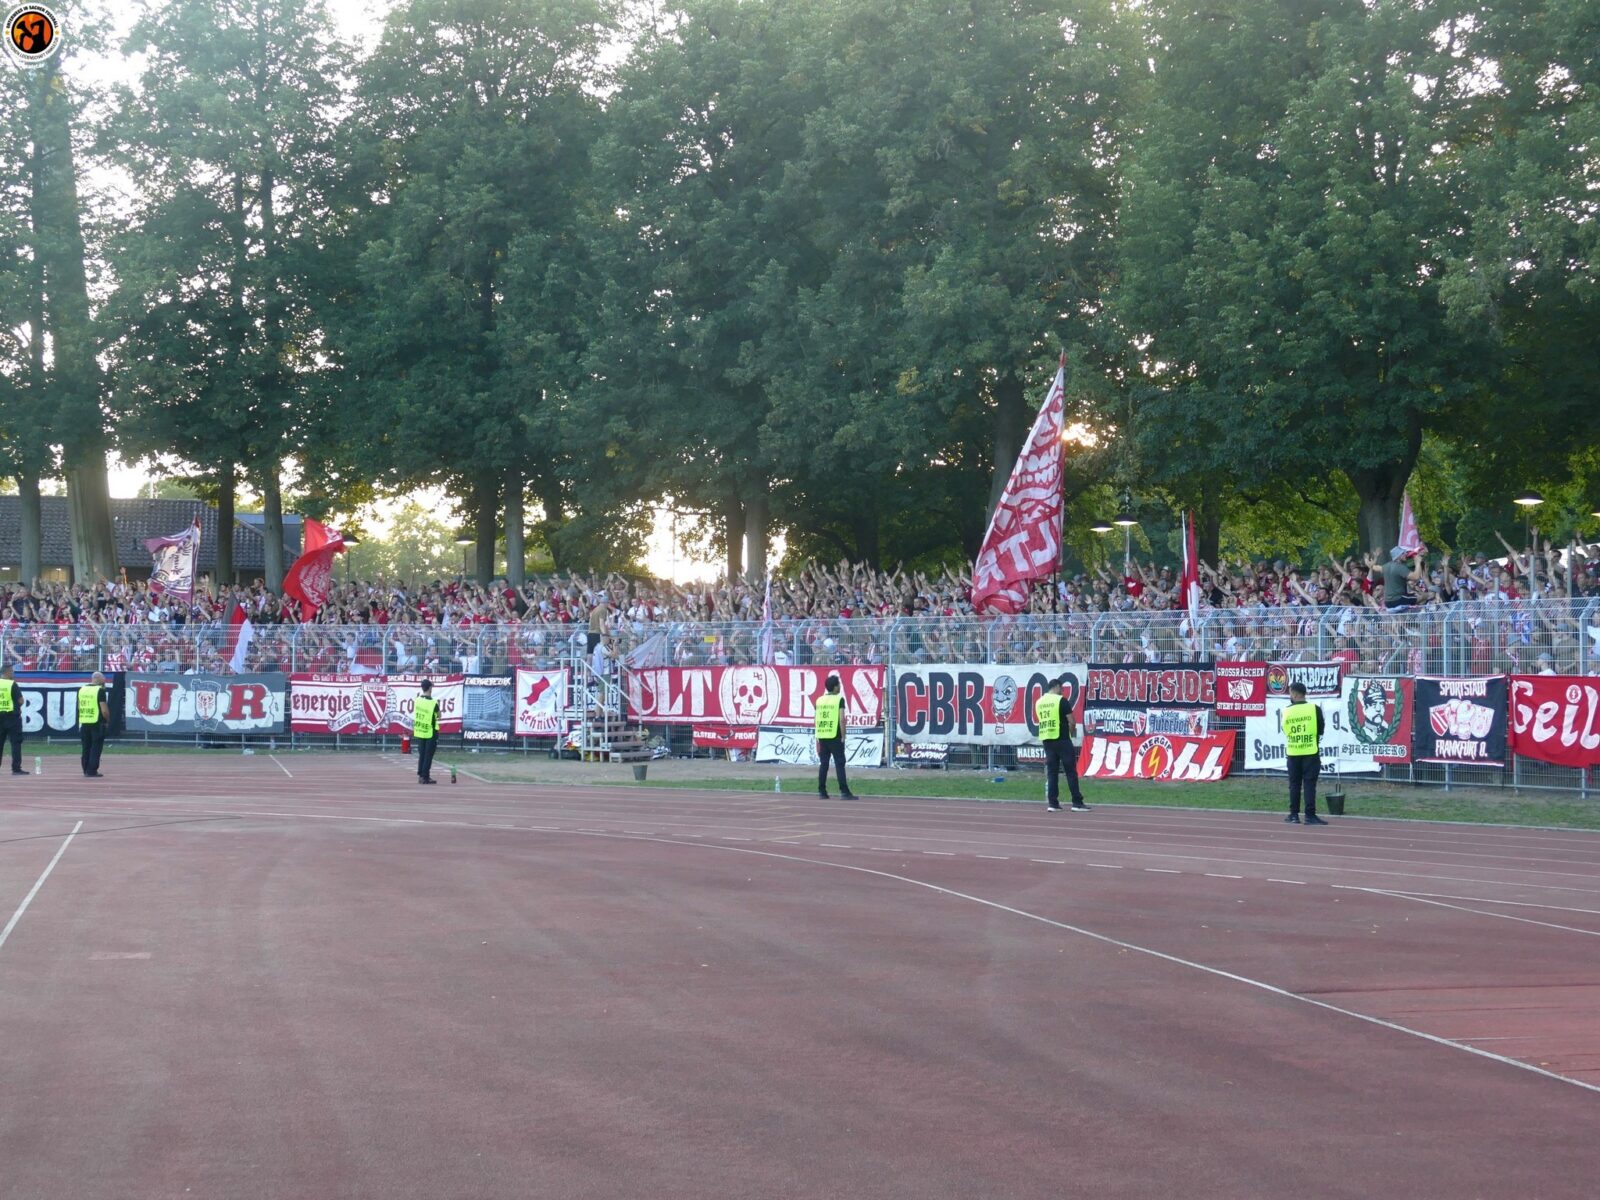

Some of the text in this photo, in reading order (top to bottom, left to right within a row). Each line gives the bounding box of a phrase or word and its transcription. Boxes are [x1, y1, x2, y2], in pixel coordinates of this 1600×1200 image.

[1287, 666, 1340, 688] VERBOTEN
[1087, 669, 1216, 704] FRONTSIDE
[1362, 680, 1392, 689] EGIE
[1440, 681, 1488, 698] SPORTSTADT
[292, 690, 455, 718] energie cous
[898, 672, 985, 737] CBR
[845, 714, 877, 726] ERGIE
[1093, 708, 1138, 722] FINSTERWALDER
[1286, 716, 1312, 724] STEWARD
[1102, 722, 1125, 734] JUNGS
[1291, 724, 1306, 733] 061
[464, 731, 508, 741] HOYERSWERDA
[693, 732, 757, 741] ELSTER FRONT
[1139, 736, 1173, 757] ENERGIE
[1435, 740, 1478, 759] FRANKFURT
[911, 750, 948, 760] COMPANY
